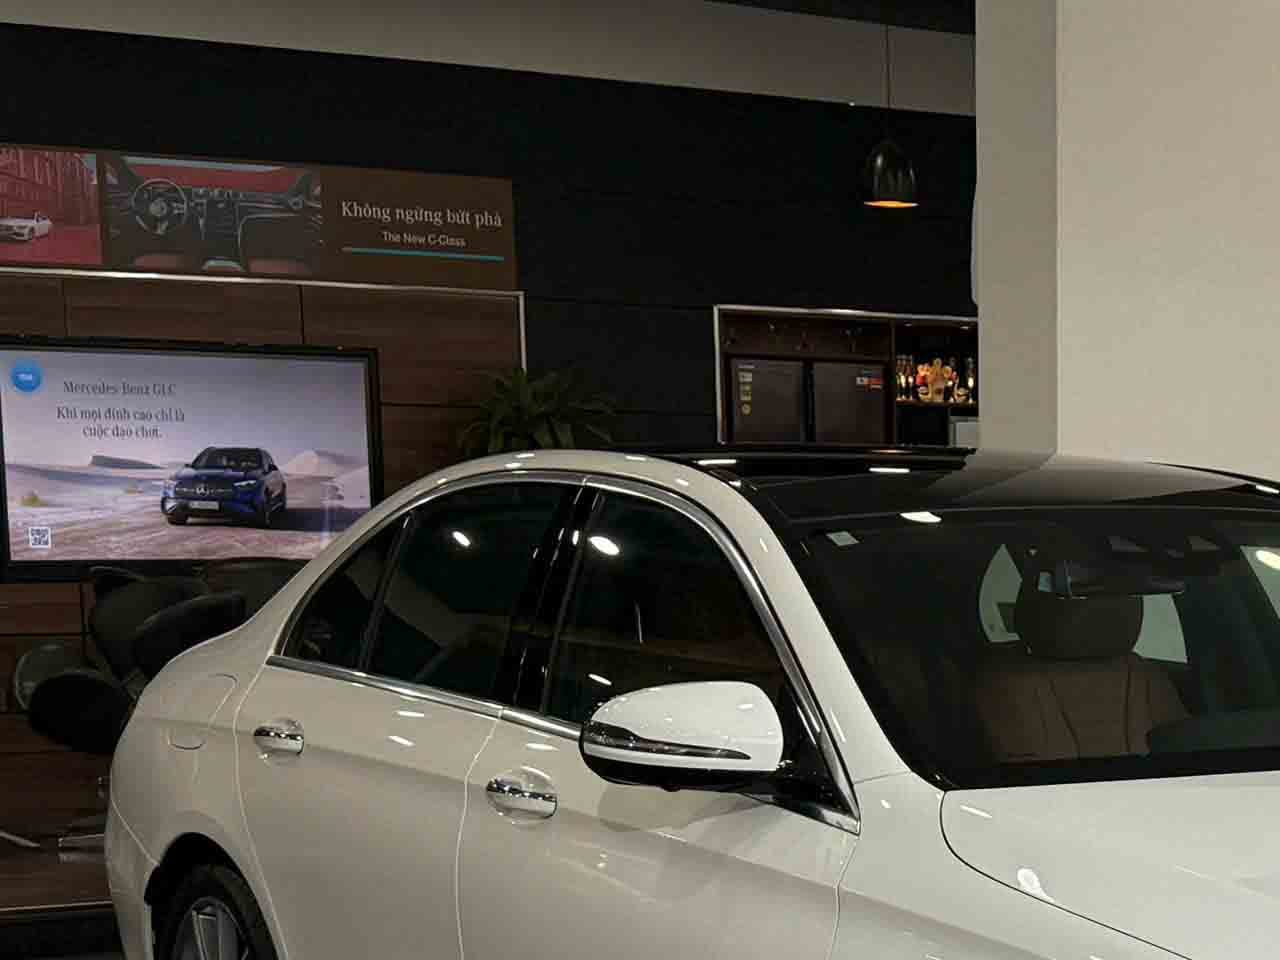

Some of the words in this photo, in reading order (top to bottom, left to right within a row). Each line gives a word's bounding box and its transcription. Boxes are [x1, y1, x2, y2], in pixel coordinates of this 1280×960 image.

[341, 201, 392, 223] Không
[395, 203, 443, 226] ngừng
[383, 231, 401, 243] The
[403, 233, 426, 245] New
[428, 234, 468, 248] C-Class
[152, 383, 177, 396] GLC
[57, 406, 78, 420] Khi
